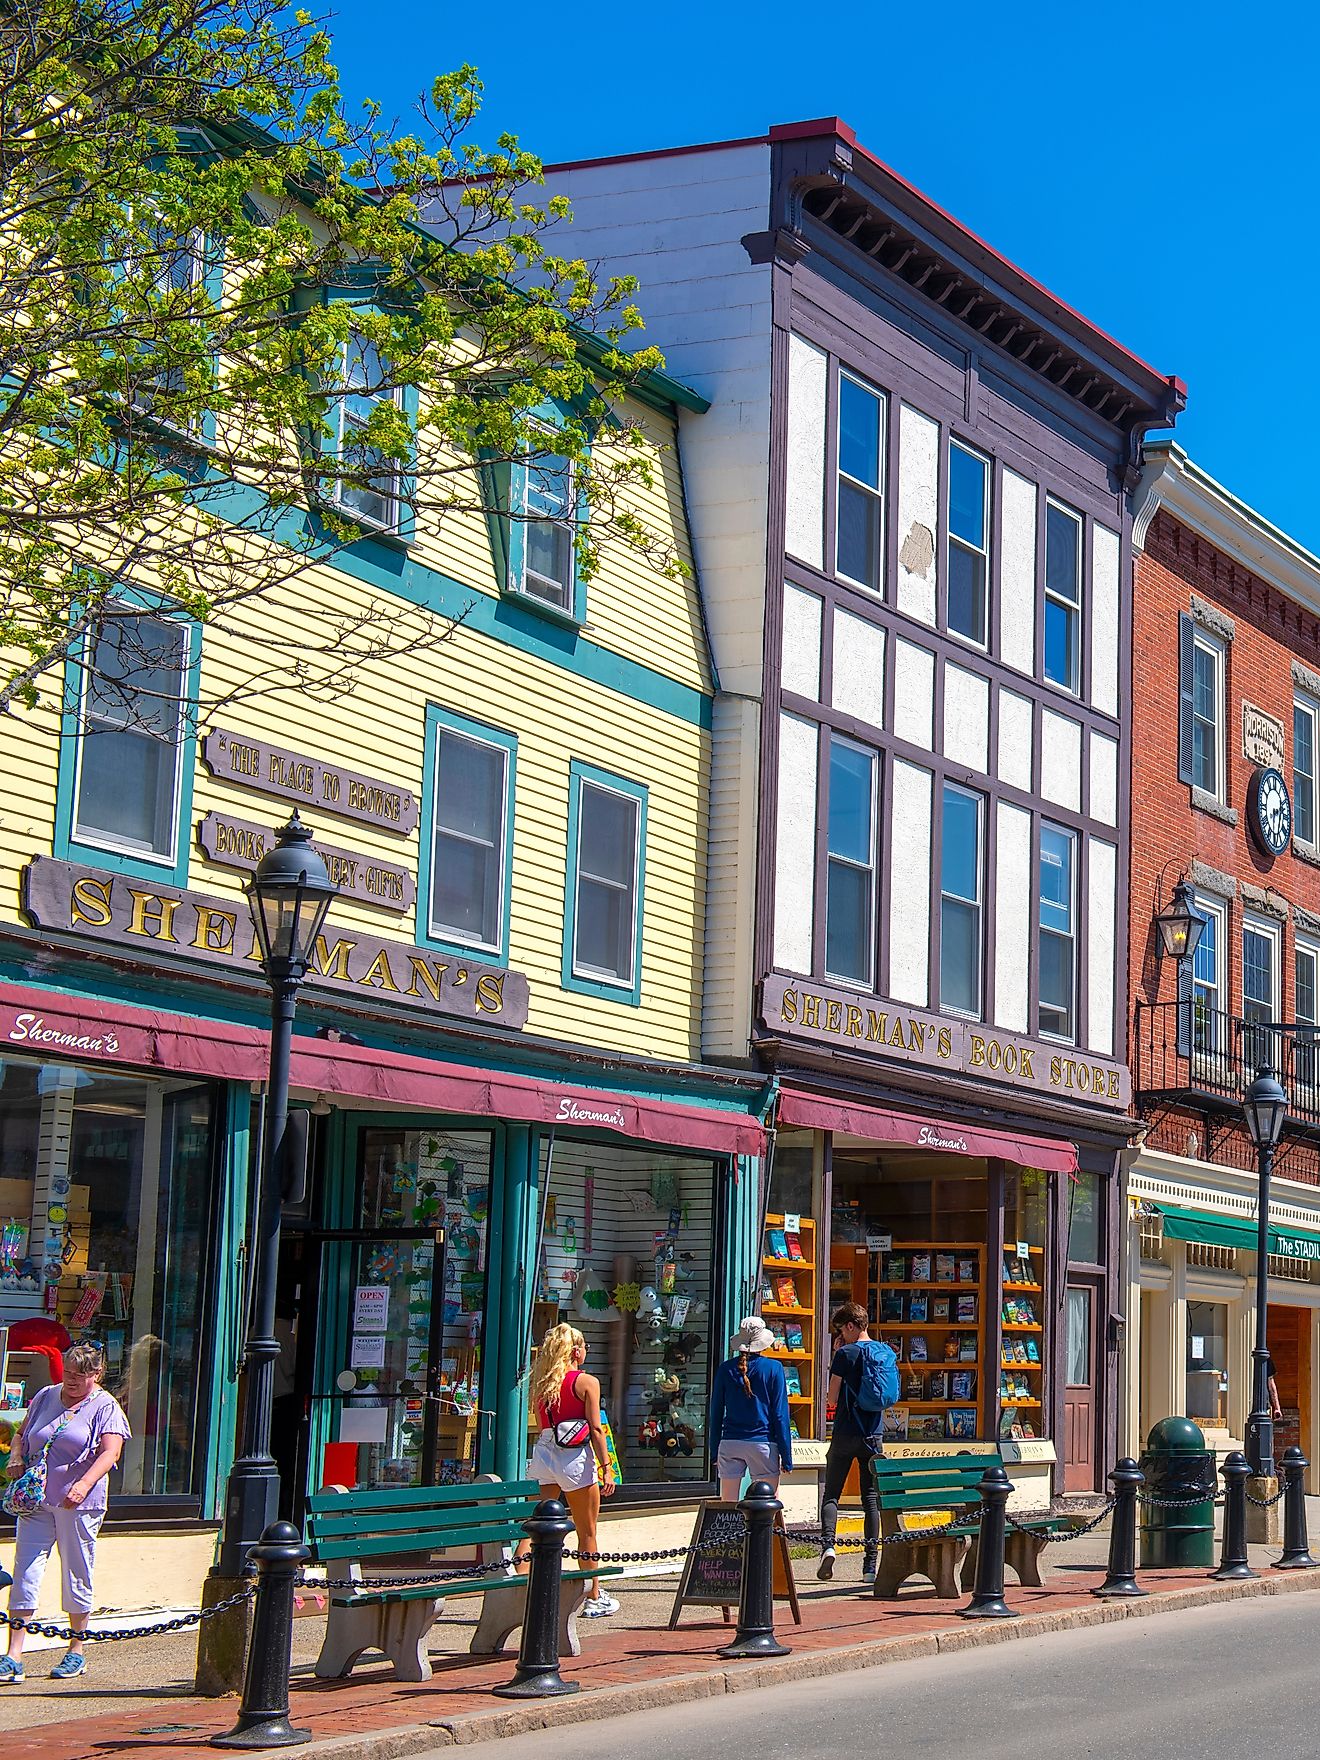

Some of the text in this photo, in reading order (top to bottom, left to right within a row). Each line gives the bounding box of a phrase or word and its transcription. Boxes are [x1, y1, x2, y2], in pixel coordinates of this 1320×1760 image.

[268, 753, 314, 795] PLACE
[322, 771, 341, 803] TO
[365, 866, 404, 901] GIFTS
[70, 876, 507, 1015] SHEMAN'S
[9, 1013, 120, 1053] Sherman's
[781, 988, 1121, 1100] SHERMAN'S BOOK STORE
[556, 1098, 625, 1127] Sherman's
[1277, 1237, 1293, 1255] The
[360, 1291, 385, 1300] OPEN
[902, 1448, 952, 1457] Bookstore
[710, 1521, 745, 1530] OLDES
[700, 1548, 726, 1557] EVERY
[698, 1560, 724, 1570] HELP
[703, 1570, 742, 1579] WANTED
